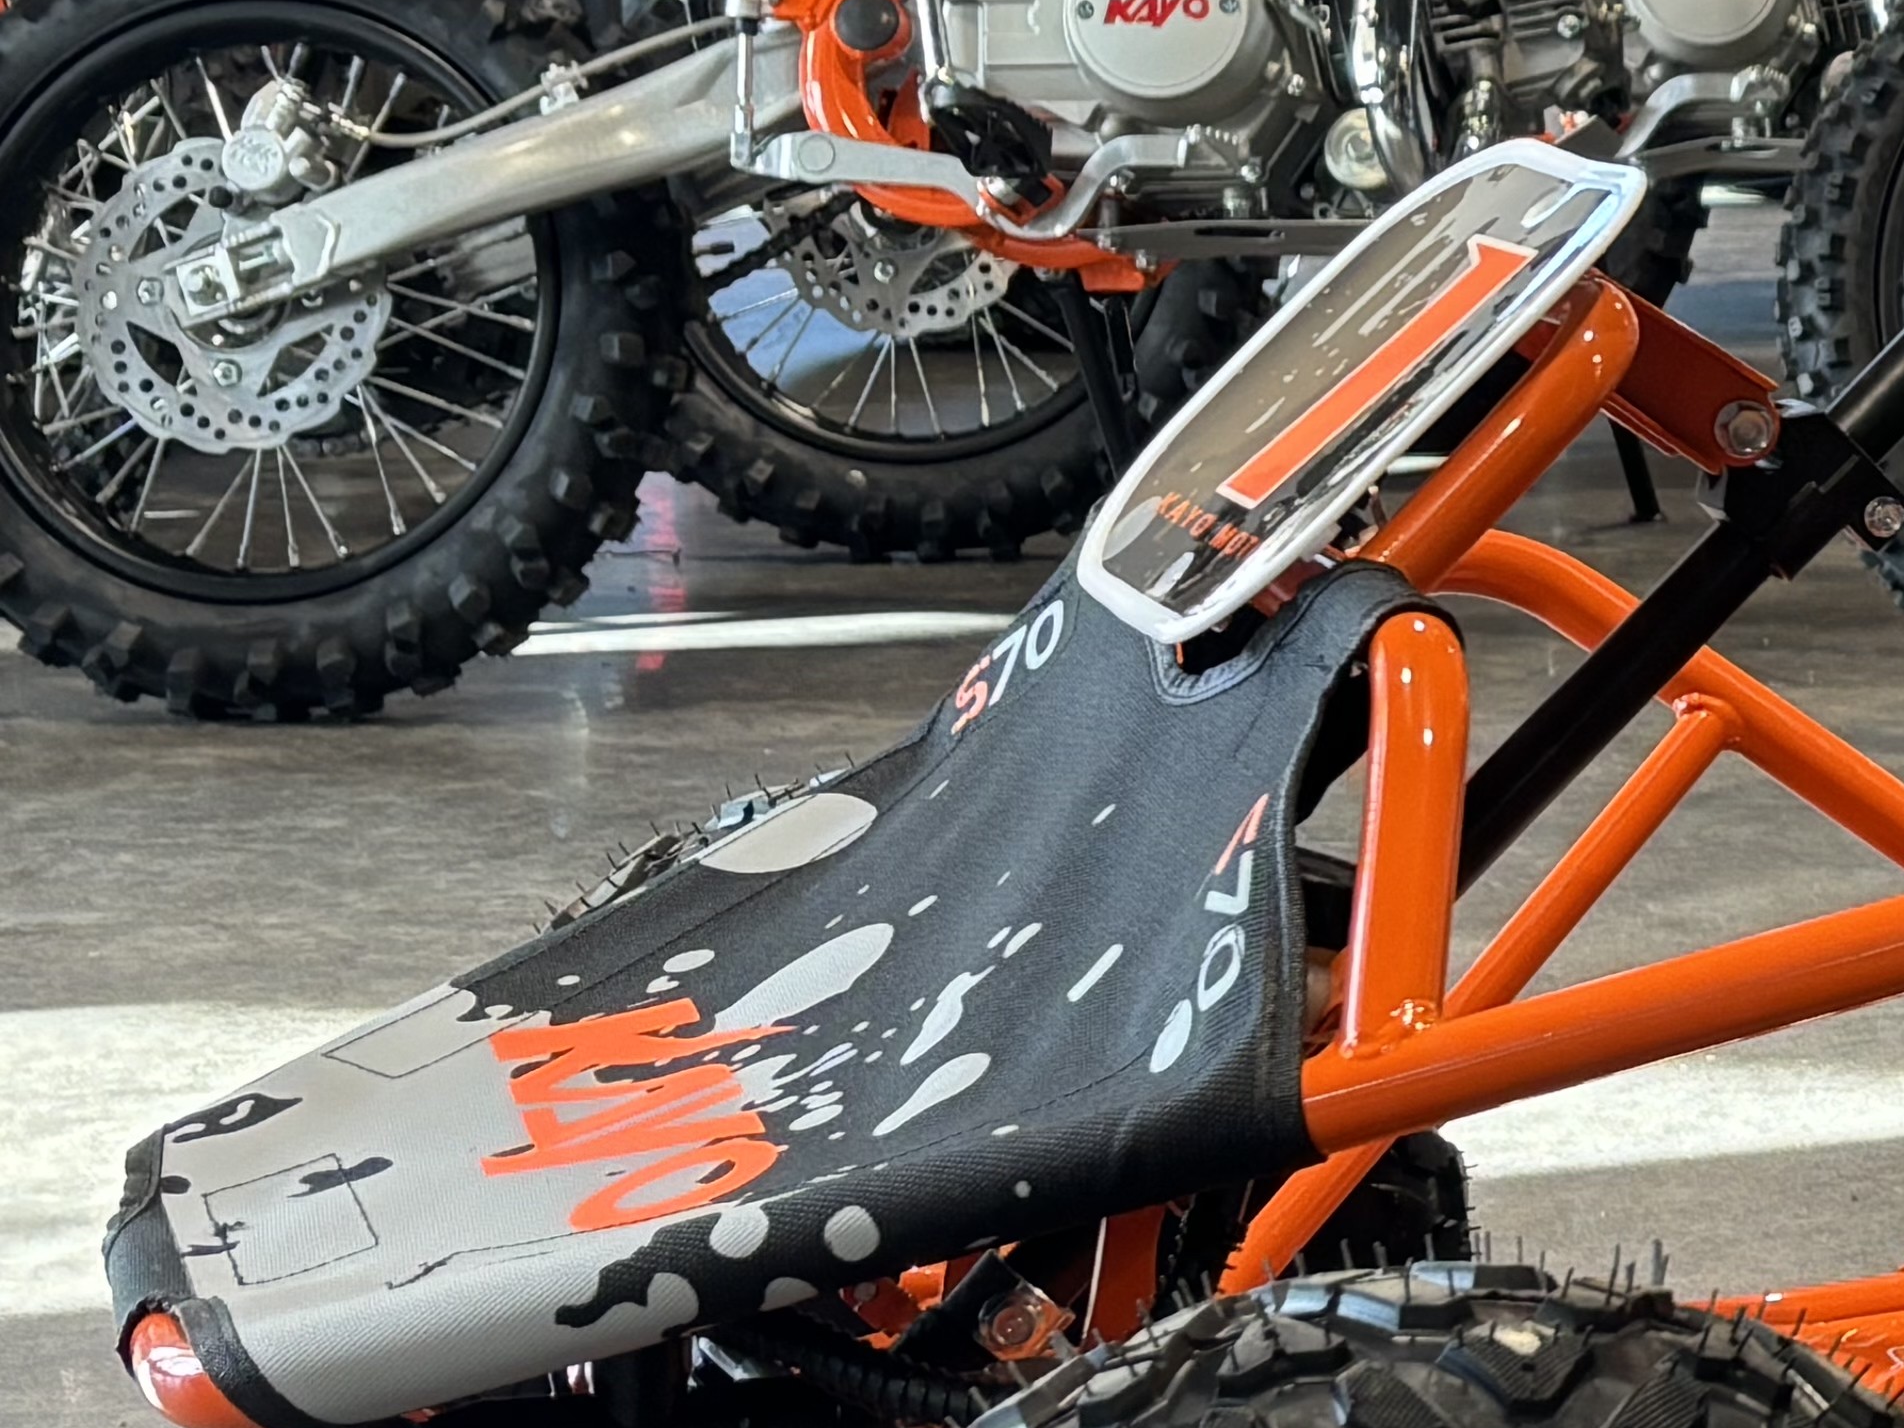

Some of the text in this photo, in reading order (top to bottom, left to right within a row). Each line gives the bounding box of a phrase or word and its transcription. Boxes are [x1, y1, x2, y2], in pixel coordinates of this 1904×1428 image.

[1156, 491, 1219, 540] KAYO
[949, 598, 1067, 737] S70
[478, 996, 800, 1234] KAYO
